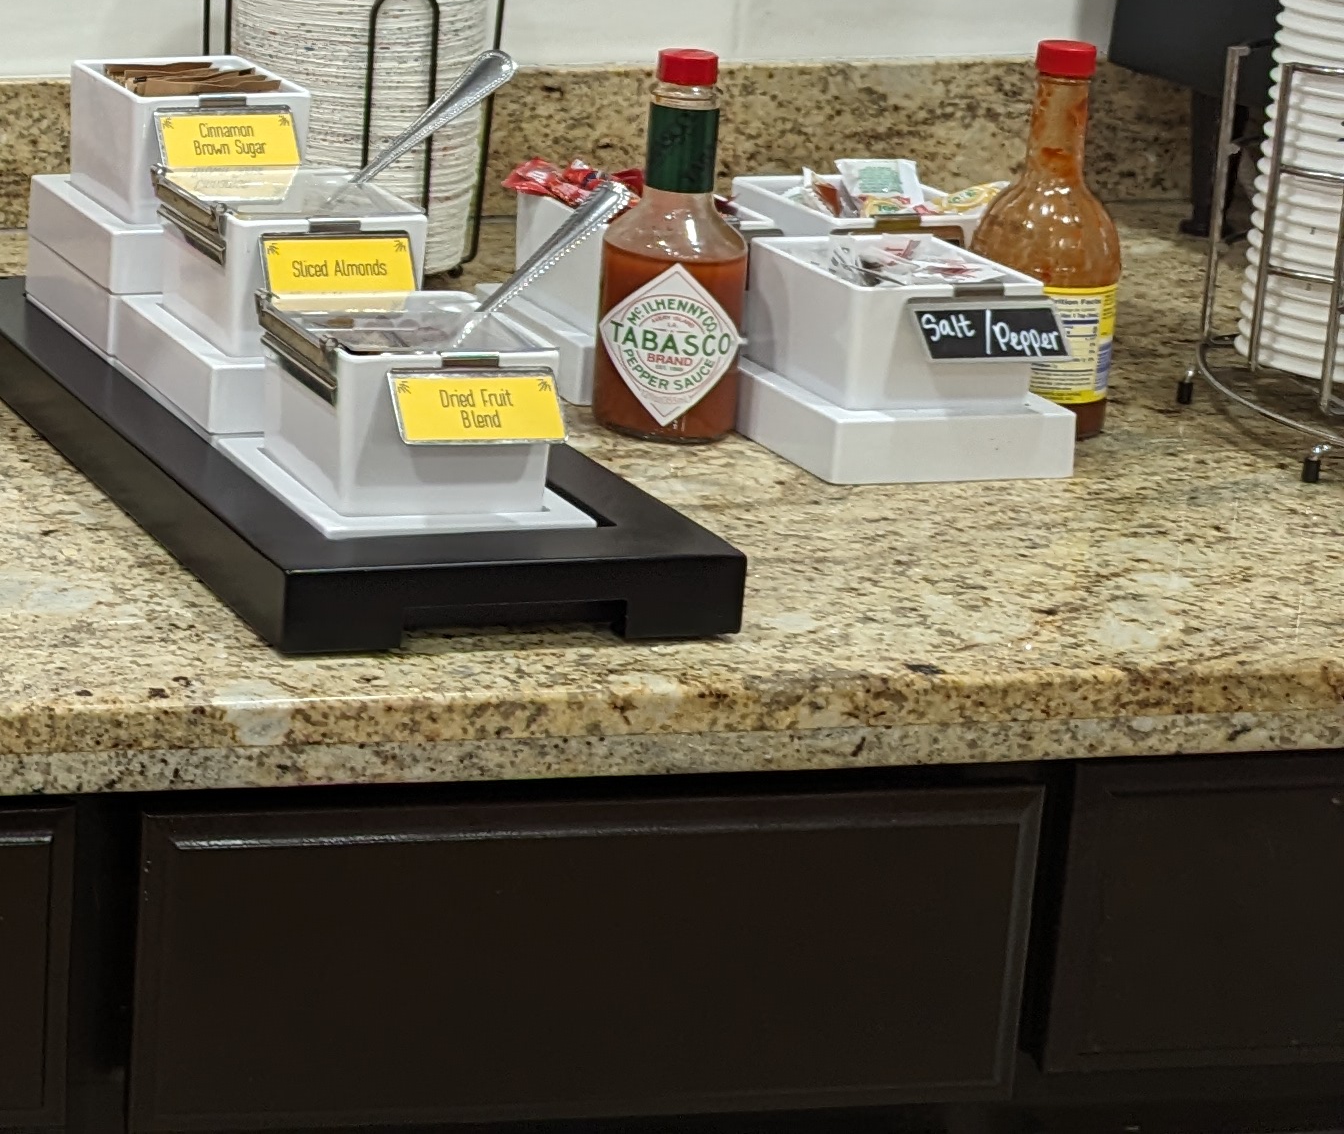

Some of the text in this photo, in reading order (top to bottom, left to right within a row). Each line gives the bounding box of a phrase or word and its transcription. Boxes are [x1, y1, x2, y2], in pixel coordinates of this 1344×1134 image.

[198, 122, 255, 138] Cinnamon
[193, 140, 267, 158] Brown Sugar
[292, 259, 387, 277] Sliced Almonds
[921, 313, 976, 342] Salt
[610, 320, 732, 357] TABASCO
[646, 353, 693, 366] BRAND
[623, 348, 714, 391] PEPPER SAUCE
[439, 388, 513, 408] Dried Fruit
[460, 409, 502, 428] Blend
